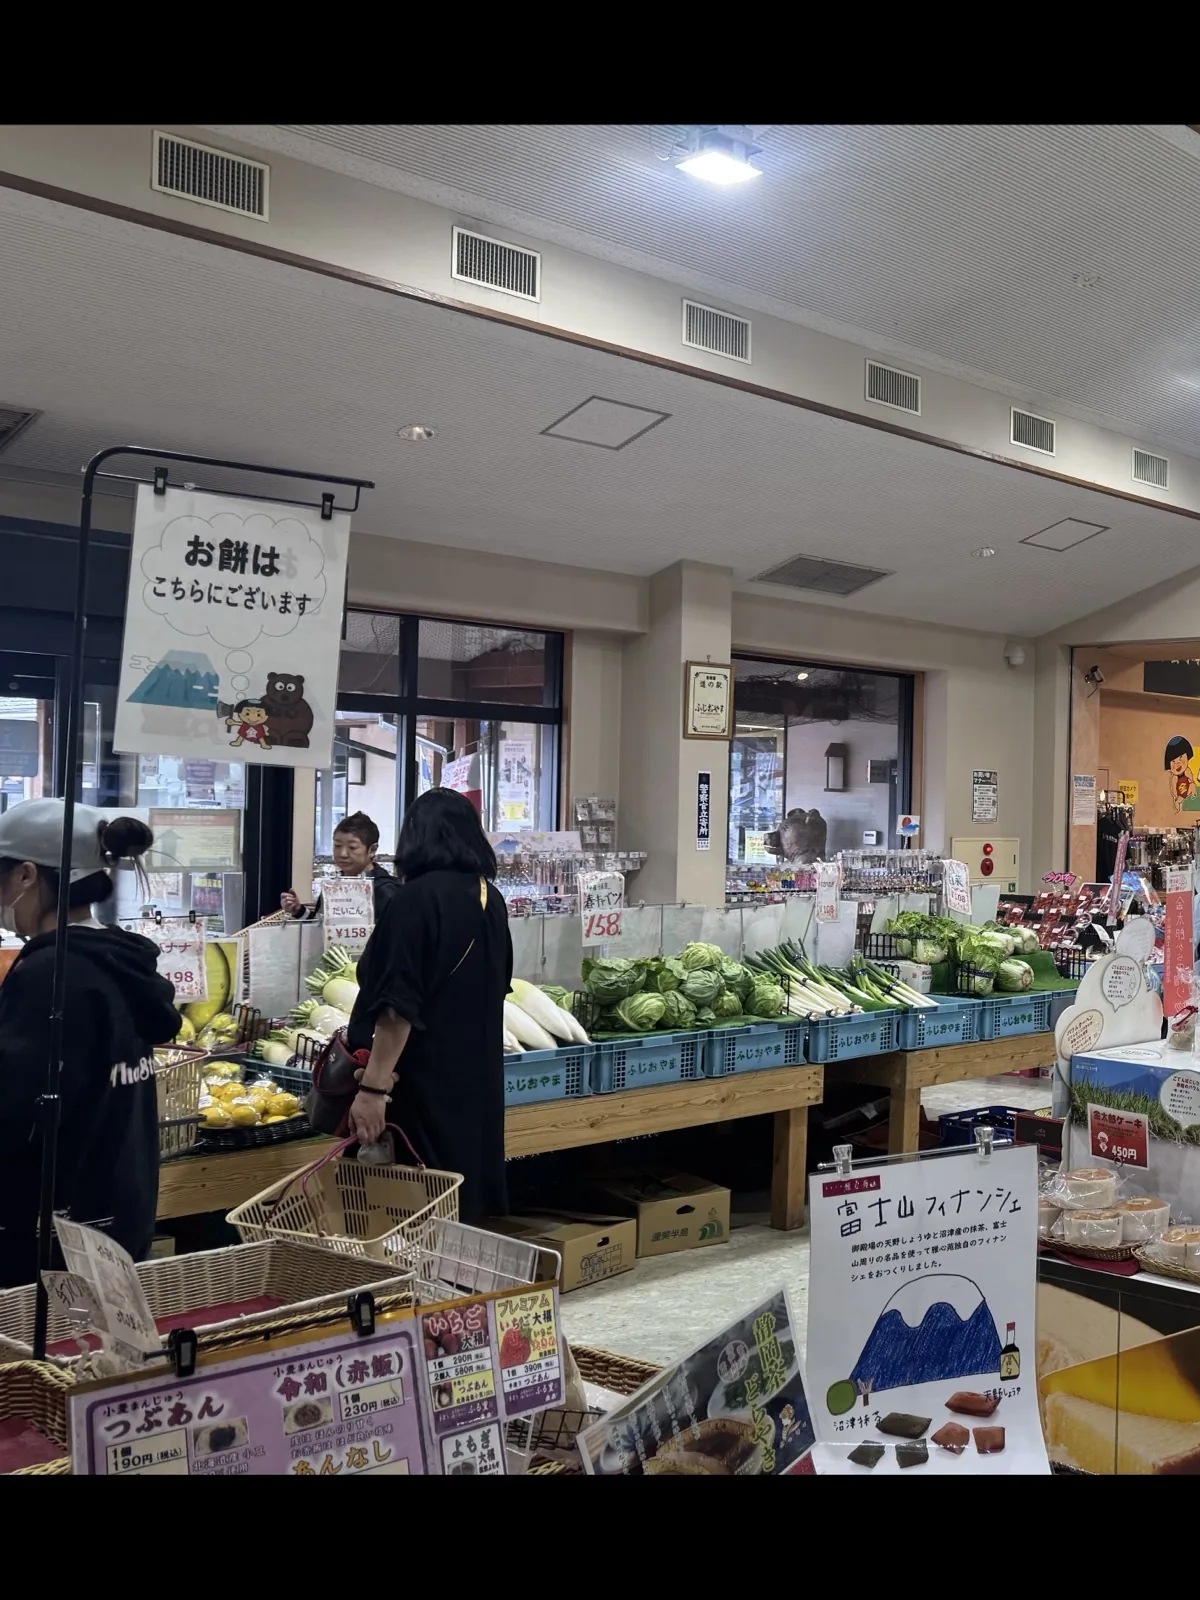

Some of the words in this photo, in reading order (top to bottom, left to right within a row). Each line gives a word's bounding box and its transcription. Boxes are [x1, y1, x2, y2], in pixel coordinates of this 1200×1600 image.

[185, 535, 280, 577] お餅は
[153, 576, 311, 616] こちらにございます
[695, 703, 724, 713] ふじおやま
[699, 784, 708, 836] 警察官立寄所
[332, 906, 364, 916] だいこん
[335, 927, 367, 938] ¥158
[585, 912, 622, 938] 158
[1001, 1013, 1033, 1026] ふじおやま
[926, 1022, 960, 1036] ふじおやま
[839, 1031, 877, 1047] ふじおやま
[736, 1044, 781, 1060] ふじおやま
[627, 1058, 677, 1076] ふじおやま
[505, 1074, 561, 1092] ふじおやま
[1093, 1110, 1143, 1129] 金太郎ケーキ
[1111, 1144, 1137, 1160] 450円
[837, 1187, 1022, 1237] 富士山フィナンシェ
[851, 1220, 1008, 1254] 御殿場の天野しょうゆと沼津産の抹茶、富士
[851, 1235, 1007, 1268] 山周りの名品を使って雅心苑独自のフィナン
[851, 1261, 942, 1282] シェをおつくりしました。
[498, 1293, 550, 1317] プレミアム
[429, 1304, 483, 1336] いちご
[500, 1314, 531, 1331] いちご
[532, 1309, 552, 1326] 大福
[462, 1331, 486, 1349] 大福
[433, 1361, 444, 1369] 1個
[453, 1354, 473, 1364] 290円
[753, 1312, 787, 1395] 静岡茶
[273, 1354, 343, 1378] 小麦まんじゅう
[434, 1372, 450, 1381] 2個入
[454, 1366, 474, 1376] 580円
[507, 1369, 517, 1377] 1個
[524, 1363, 542, 1372] 390円
[458, 1379, 488, 1394] つぶあん
[523, 1372, 550, 1385] つぶあん
[103, 1391, 184, 1417] 小麦まんじゅう
[343, 1393, 361, 1406] 1個
[104, 1395, 224, 1439] つぶあん
[344, 1402, 378, 1418] 230円
[315, 1416, 374, 1444] ほんのり甘く
[744, 1372, 776, 1473] どらやき
[110, 1445, 132, 1459] 1個
[243, 1445, 266, 1459] 小豆
[452, 1428, 491, 1458] よもぎ
[109, 1455, 153, 1473] 190円
[156, 1447, 182, 1462] (税込)
[291, 1440, 392, 1475] あんなし
[478, 1448, 495, 1464] 大福
